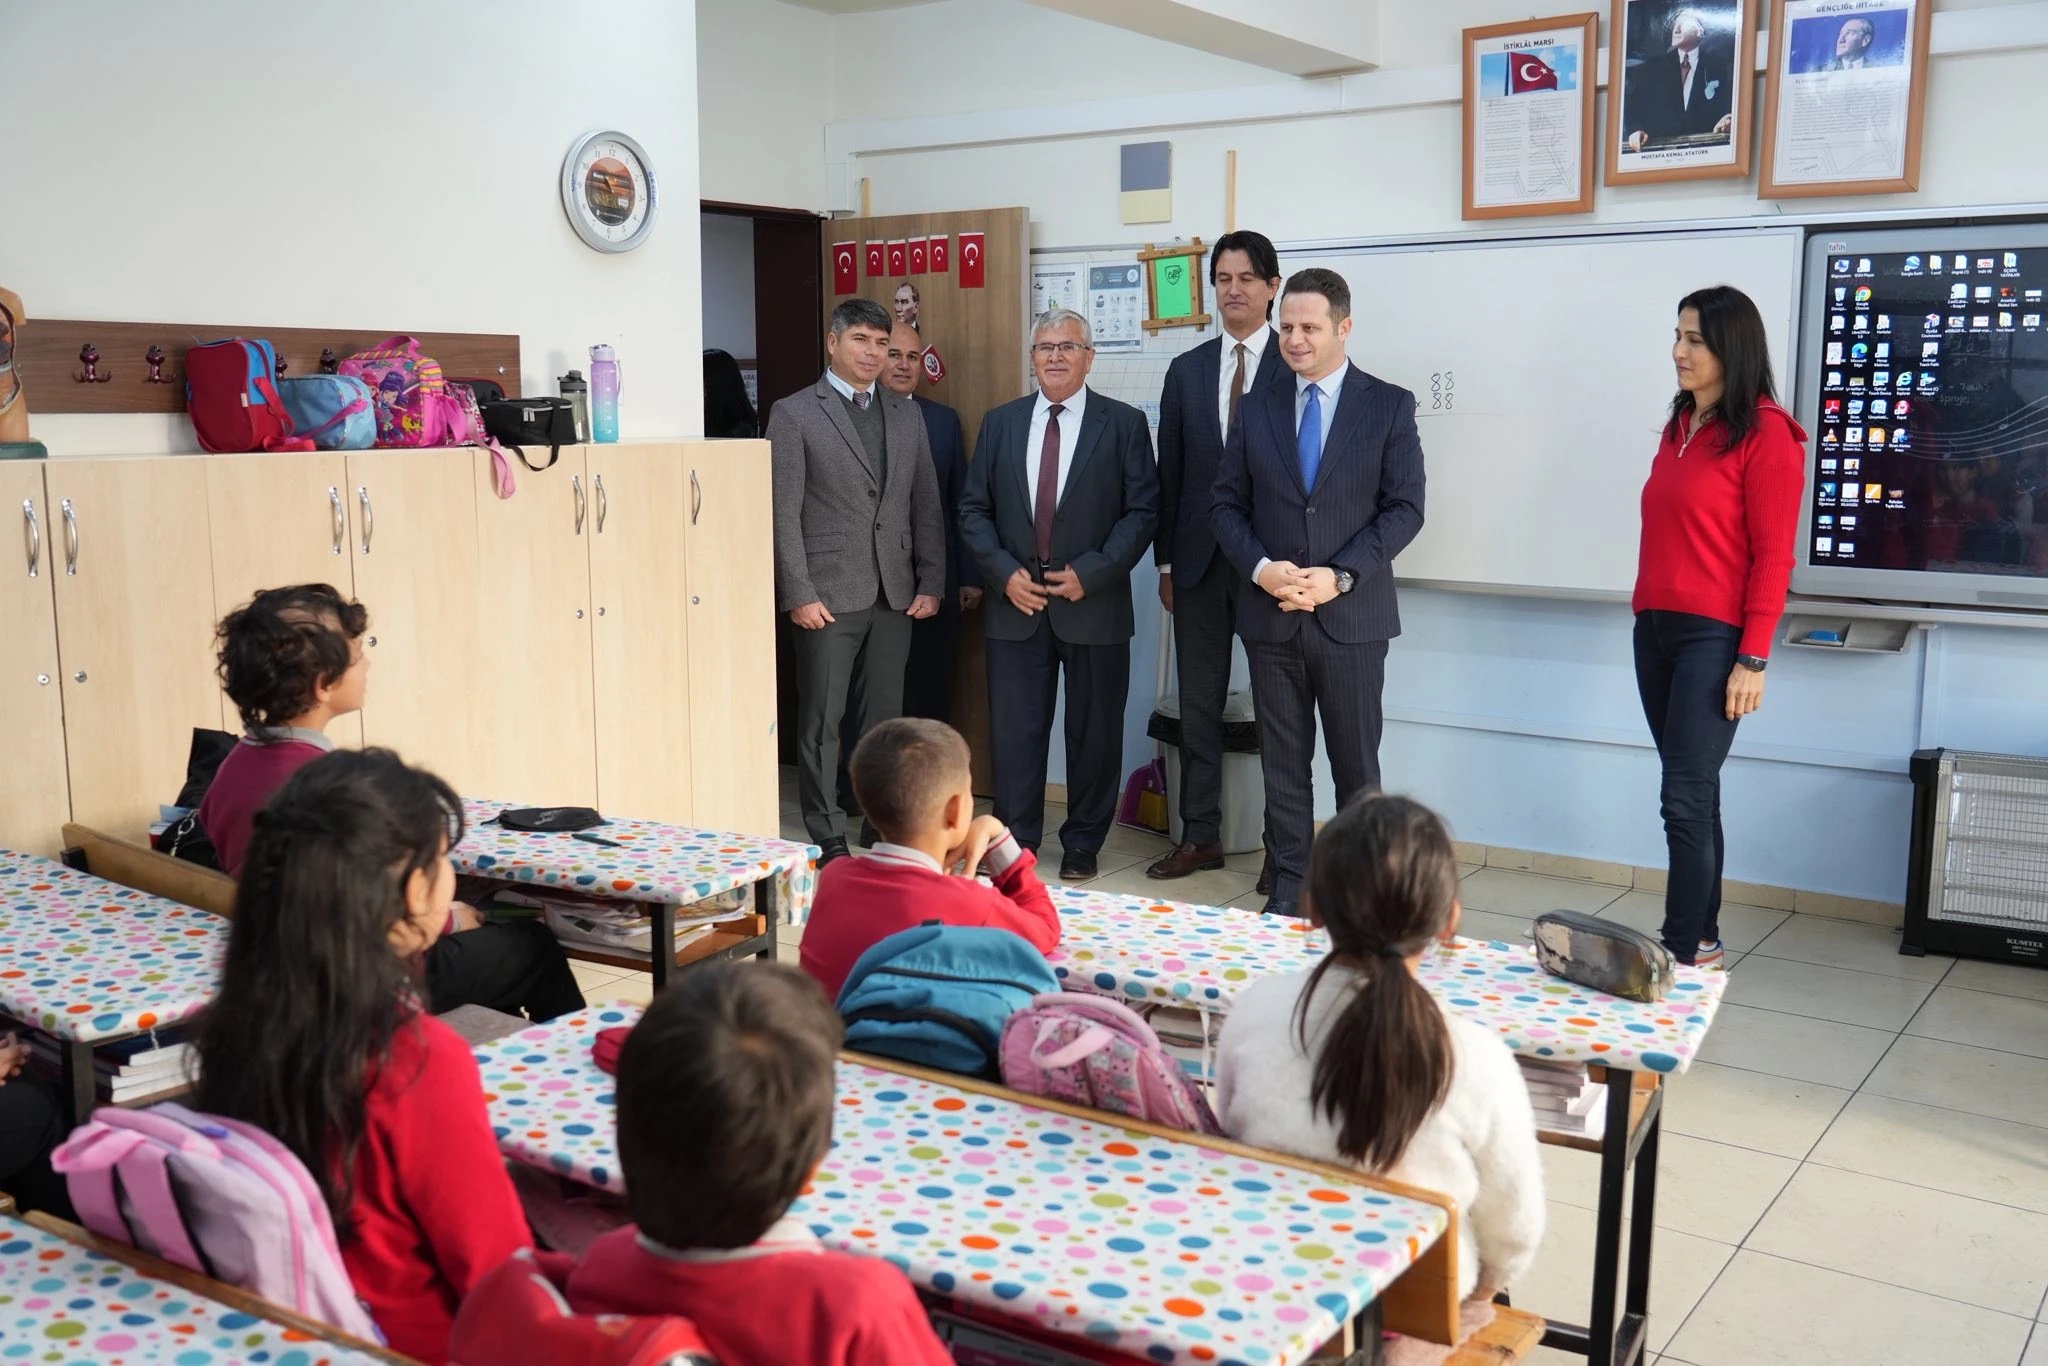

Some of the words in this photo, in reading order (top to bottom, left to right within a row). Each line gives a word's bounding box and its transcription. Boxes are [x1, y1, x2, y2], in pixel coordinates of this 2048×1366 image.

[1684, 149, 1708, 157] ATATÜRK
[1431, 371, 1454, 392] 88
[1432, 393, 1454, 409] 88
[2007, 938, 2045, 948] KUMTEL
